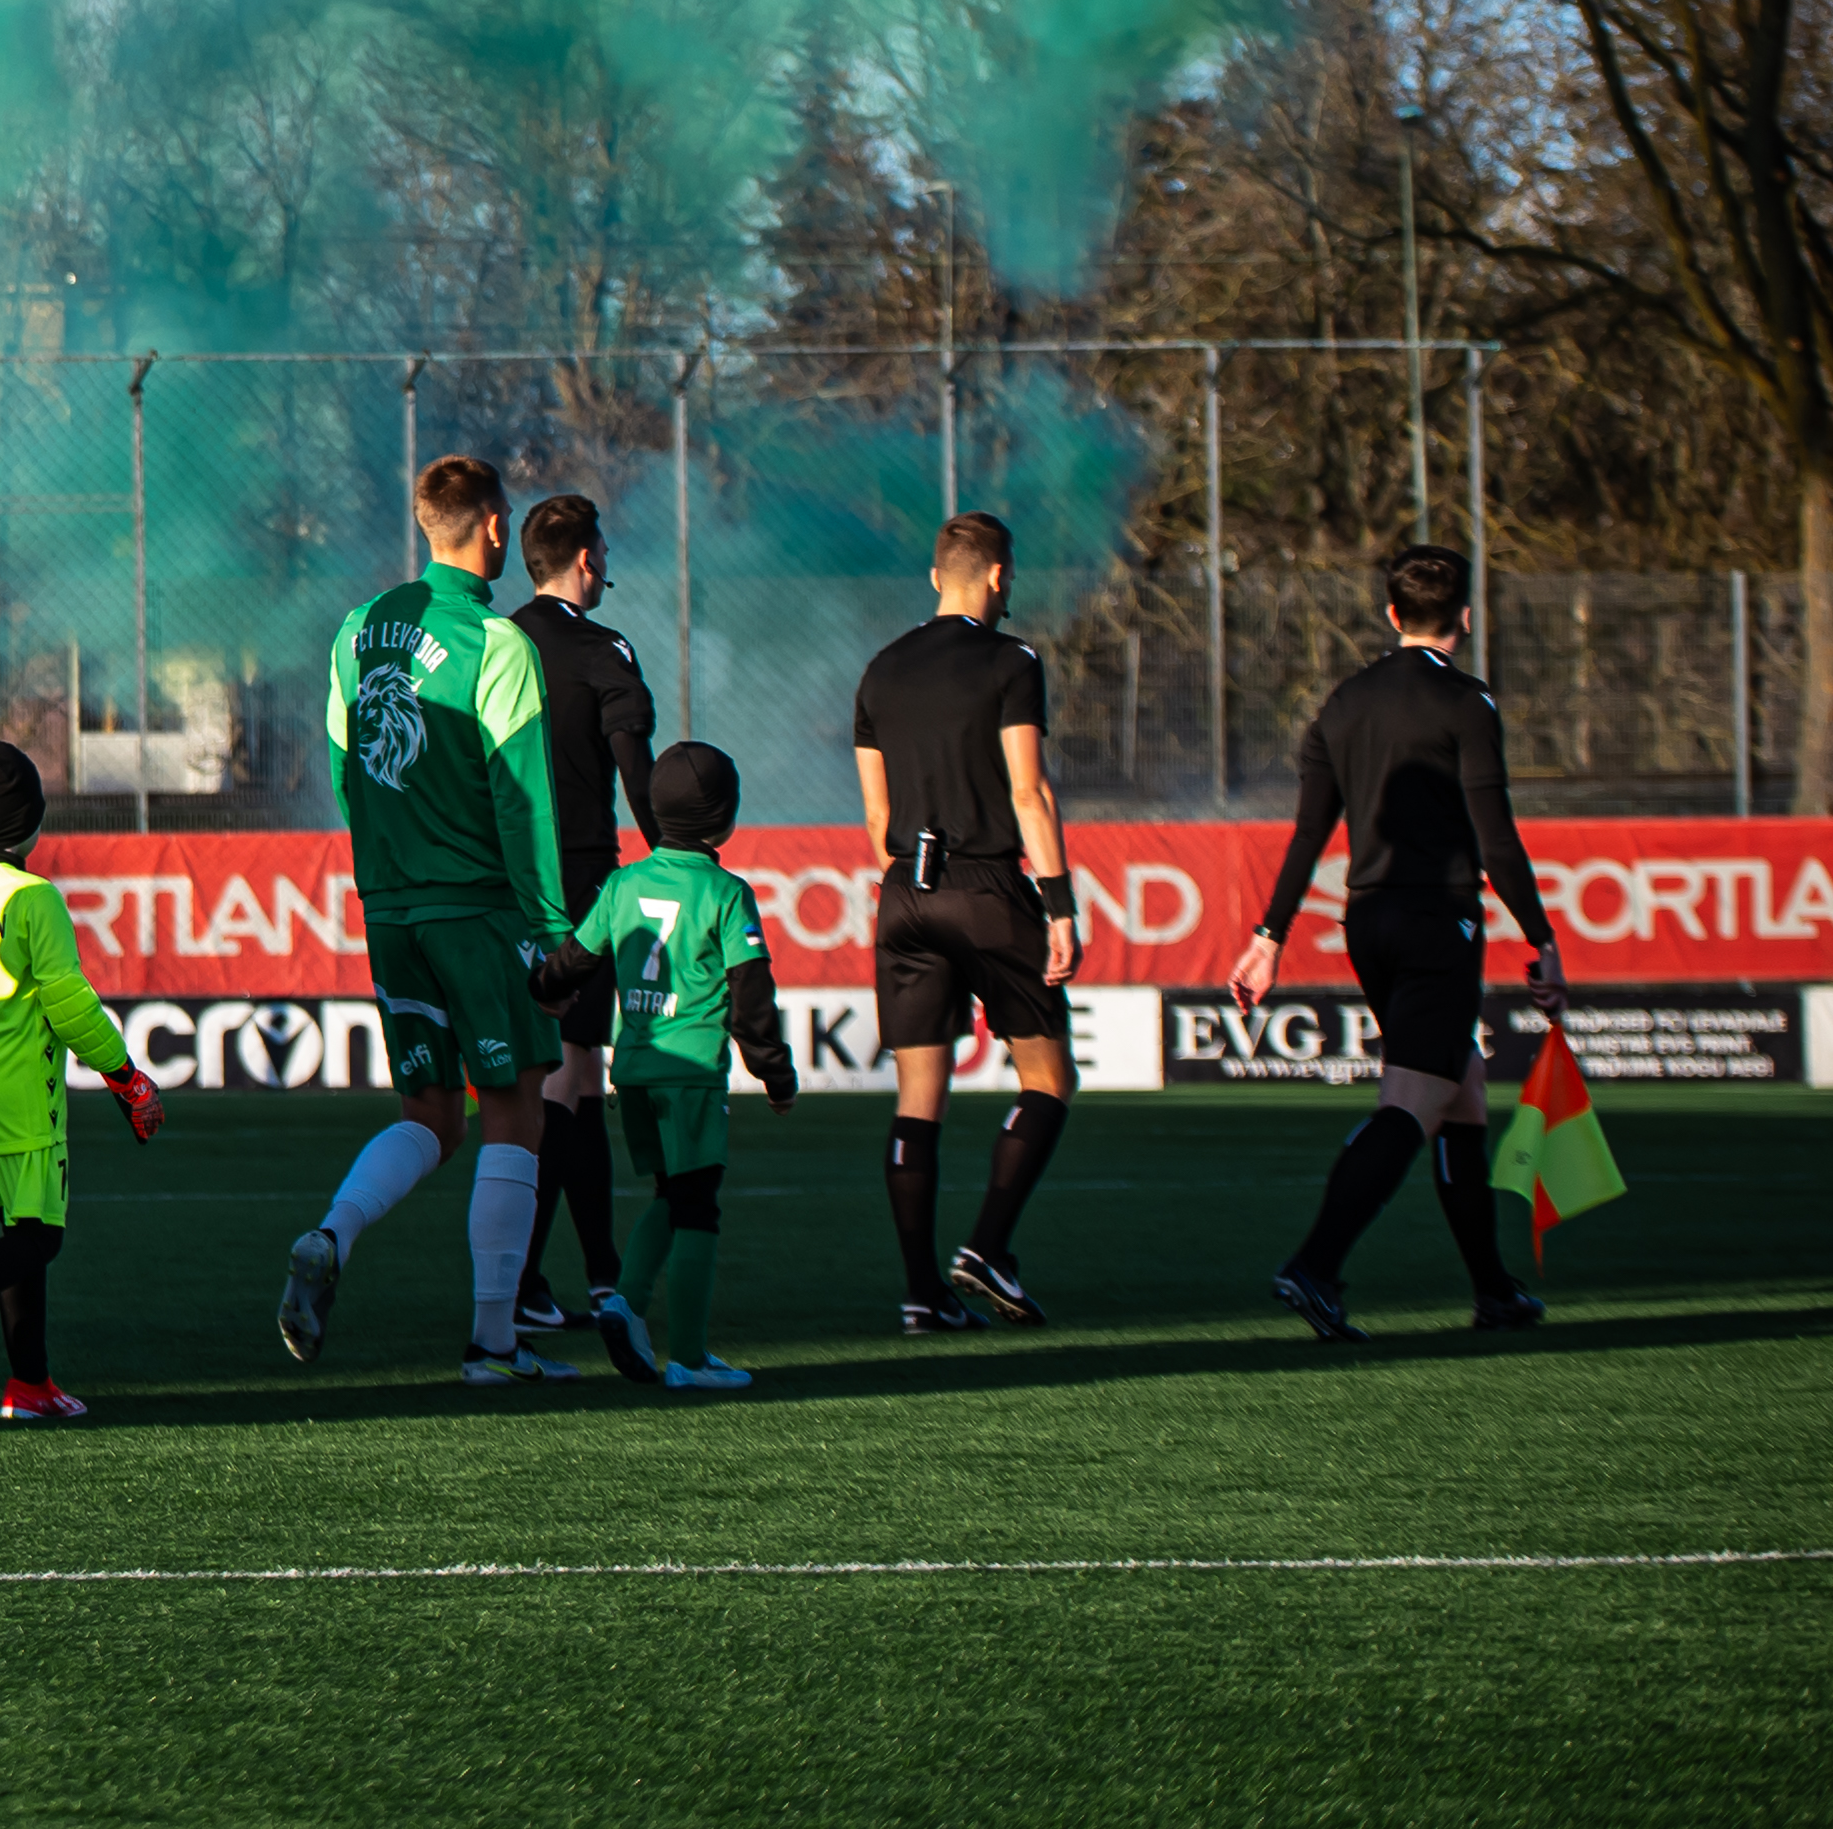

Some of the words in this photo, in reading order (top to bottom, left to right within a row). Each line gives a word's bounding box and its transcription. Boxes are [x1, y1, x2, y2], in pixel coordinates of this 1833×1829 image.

[351, 623, 375, 660] FCI
[380, 620, 449, 674] LEVADIA
[638, 896, 681, 982] 7
[400, 1042, 432, 1077] elfi
[1171, 1002, 1327, 1061] EVG
